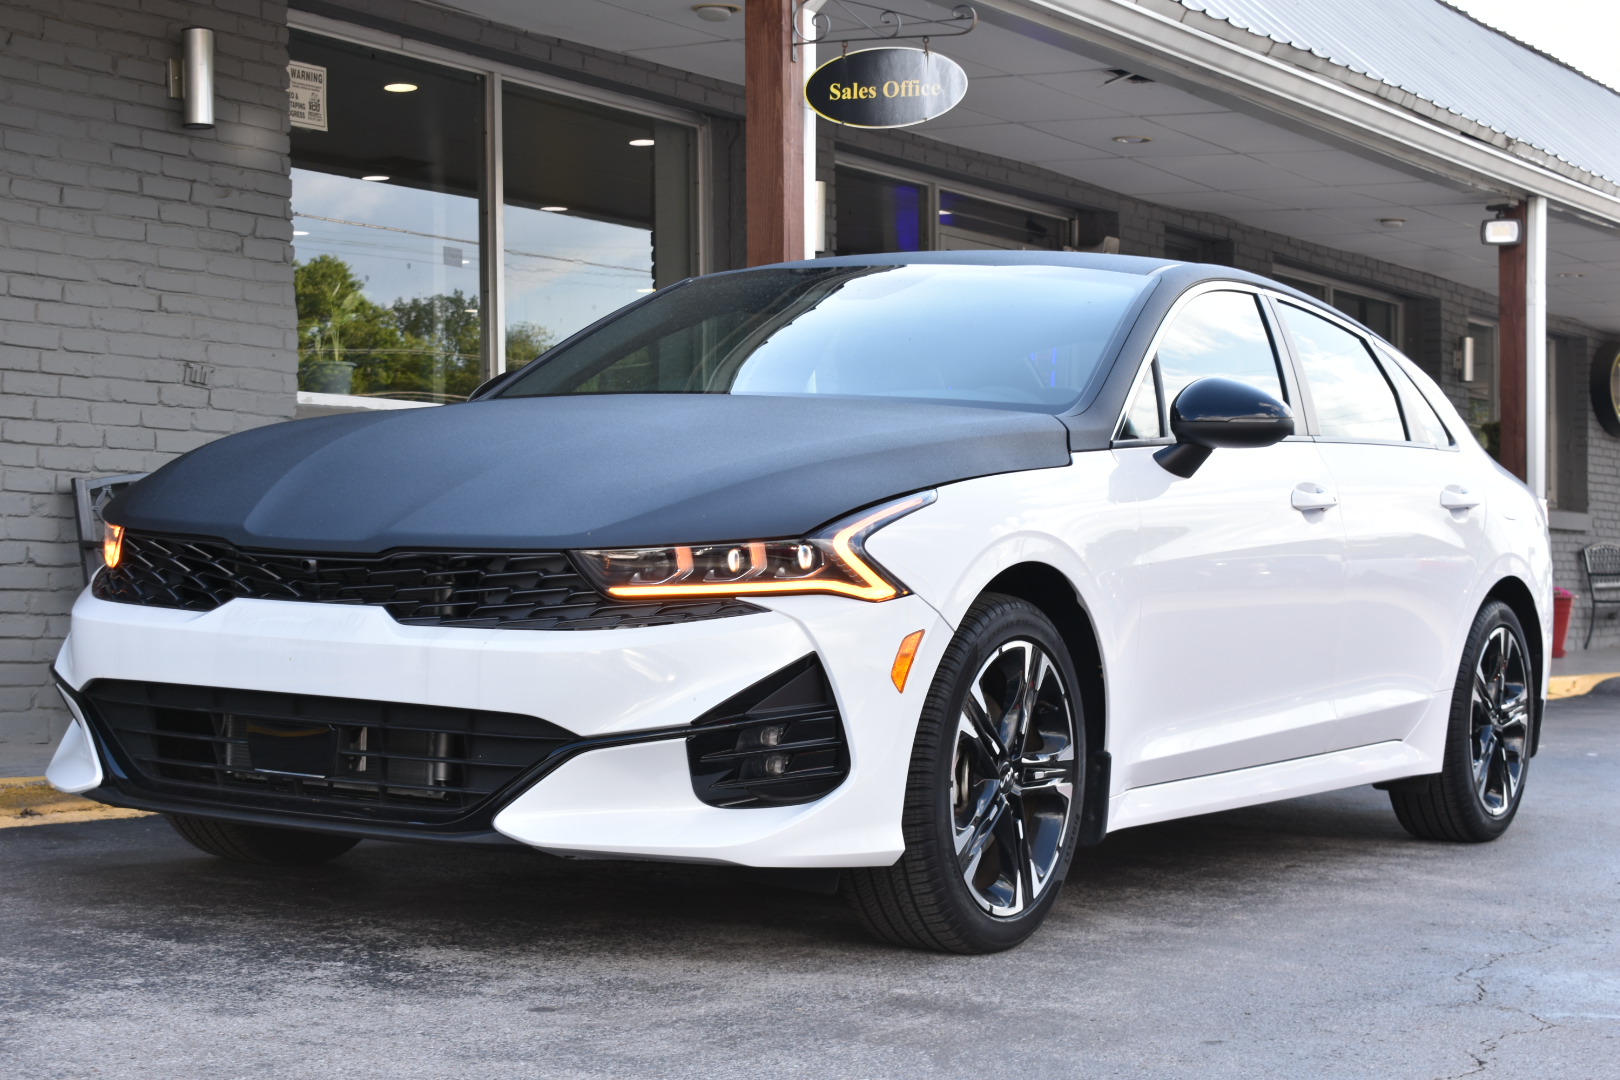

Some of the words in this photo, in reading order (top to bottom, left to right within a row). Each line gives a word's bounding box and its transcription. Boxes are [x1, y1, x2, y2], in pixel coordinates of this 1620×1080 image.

[290, 67, 323, 84] WARNING
[829, 82, 877, 101] Sales
[883, 80, 941, 98] Office
